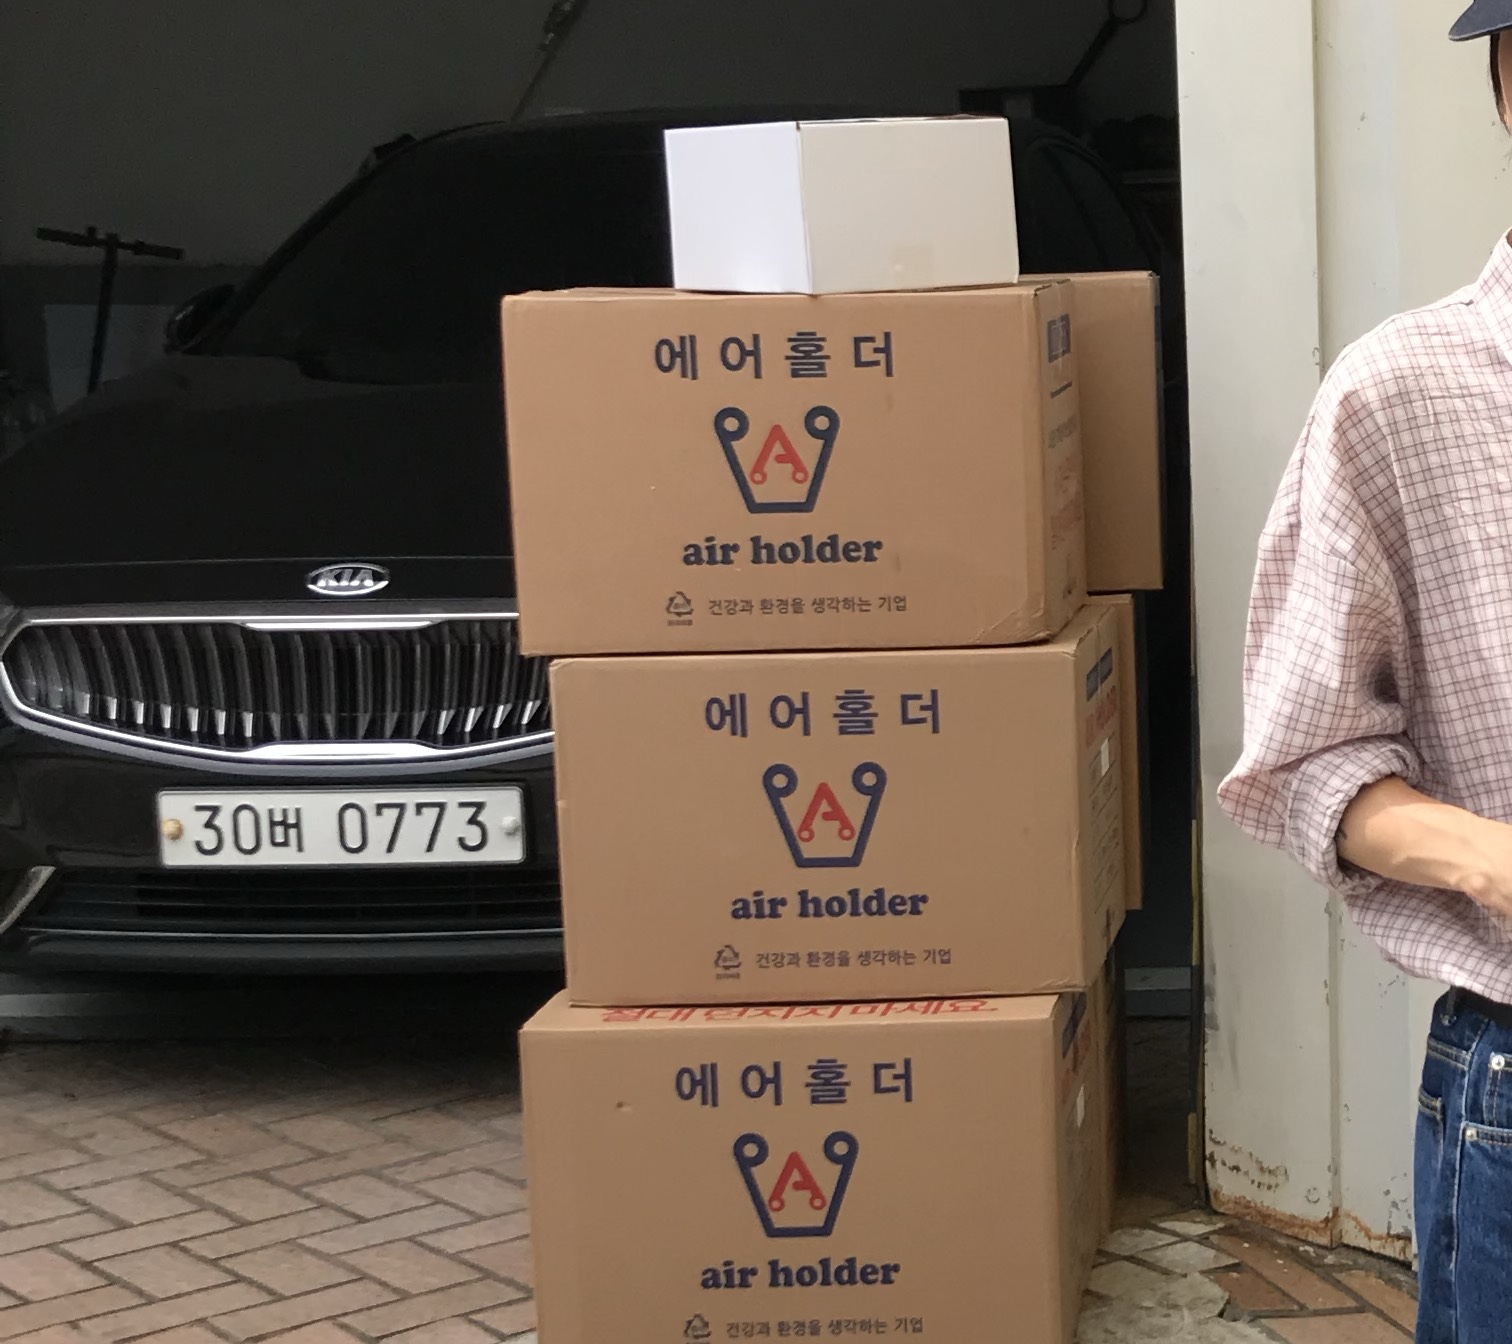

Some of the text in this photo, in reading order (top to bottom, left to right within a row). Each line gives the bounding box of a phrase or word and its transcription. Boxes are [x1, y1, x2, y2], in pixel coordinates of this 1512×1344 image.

[683, 534, 883, 566] air holder
[316, 568, 374, 587] KIA
[708, 595, 907, 616] 건강과 환경을 생각하는 기업
[194, 802, 489, 856] 30버 0773
[731, 888, 929, 920] air holder
[756, 948, 952, 969] 건강과 환경을 생각하는 기업
[700, 1257, 900, 1290] air holder
[726, 1322, 771, 1339] 건강과
[828, 1318, 887, 1336] 생각하는
[894, 1317, 923, 1334] 기업
